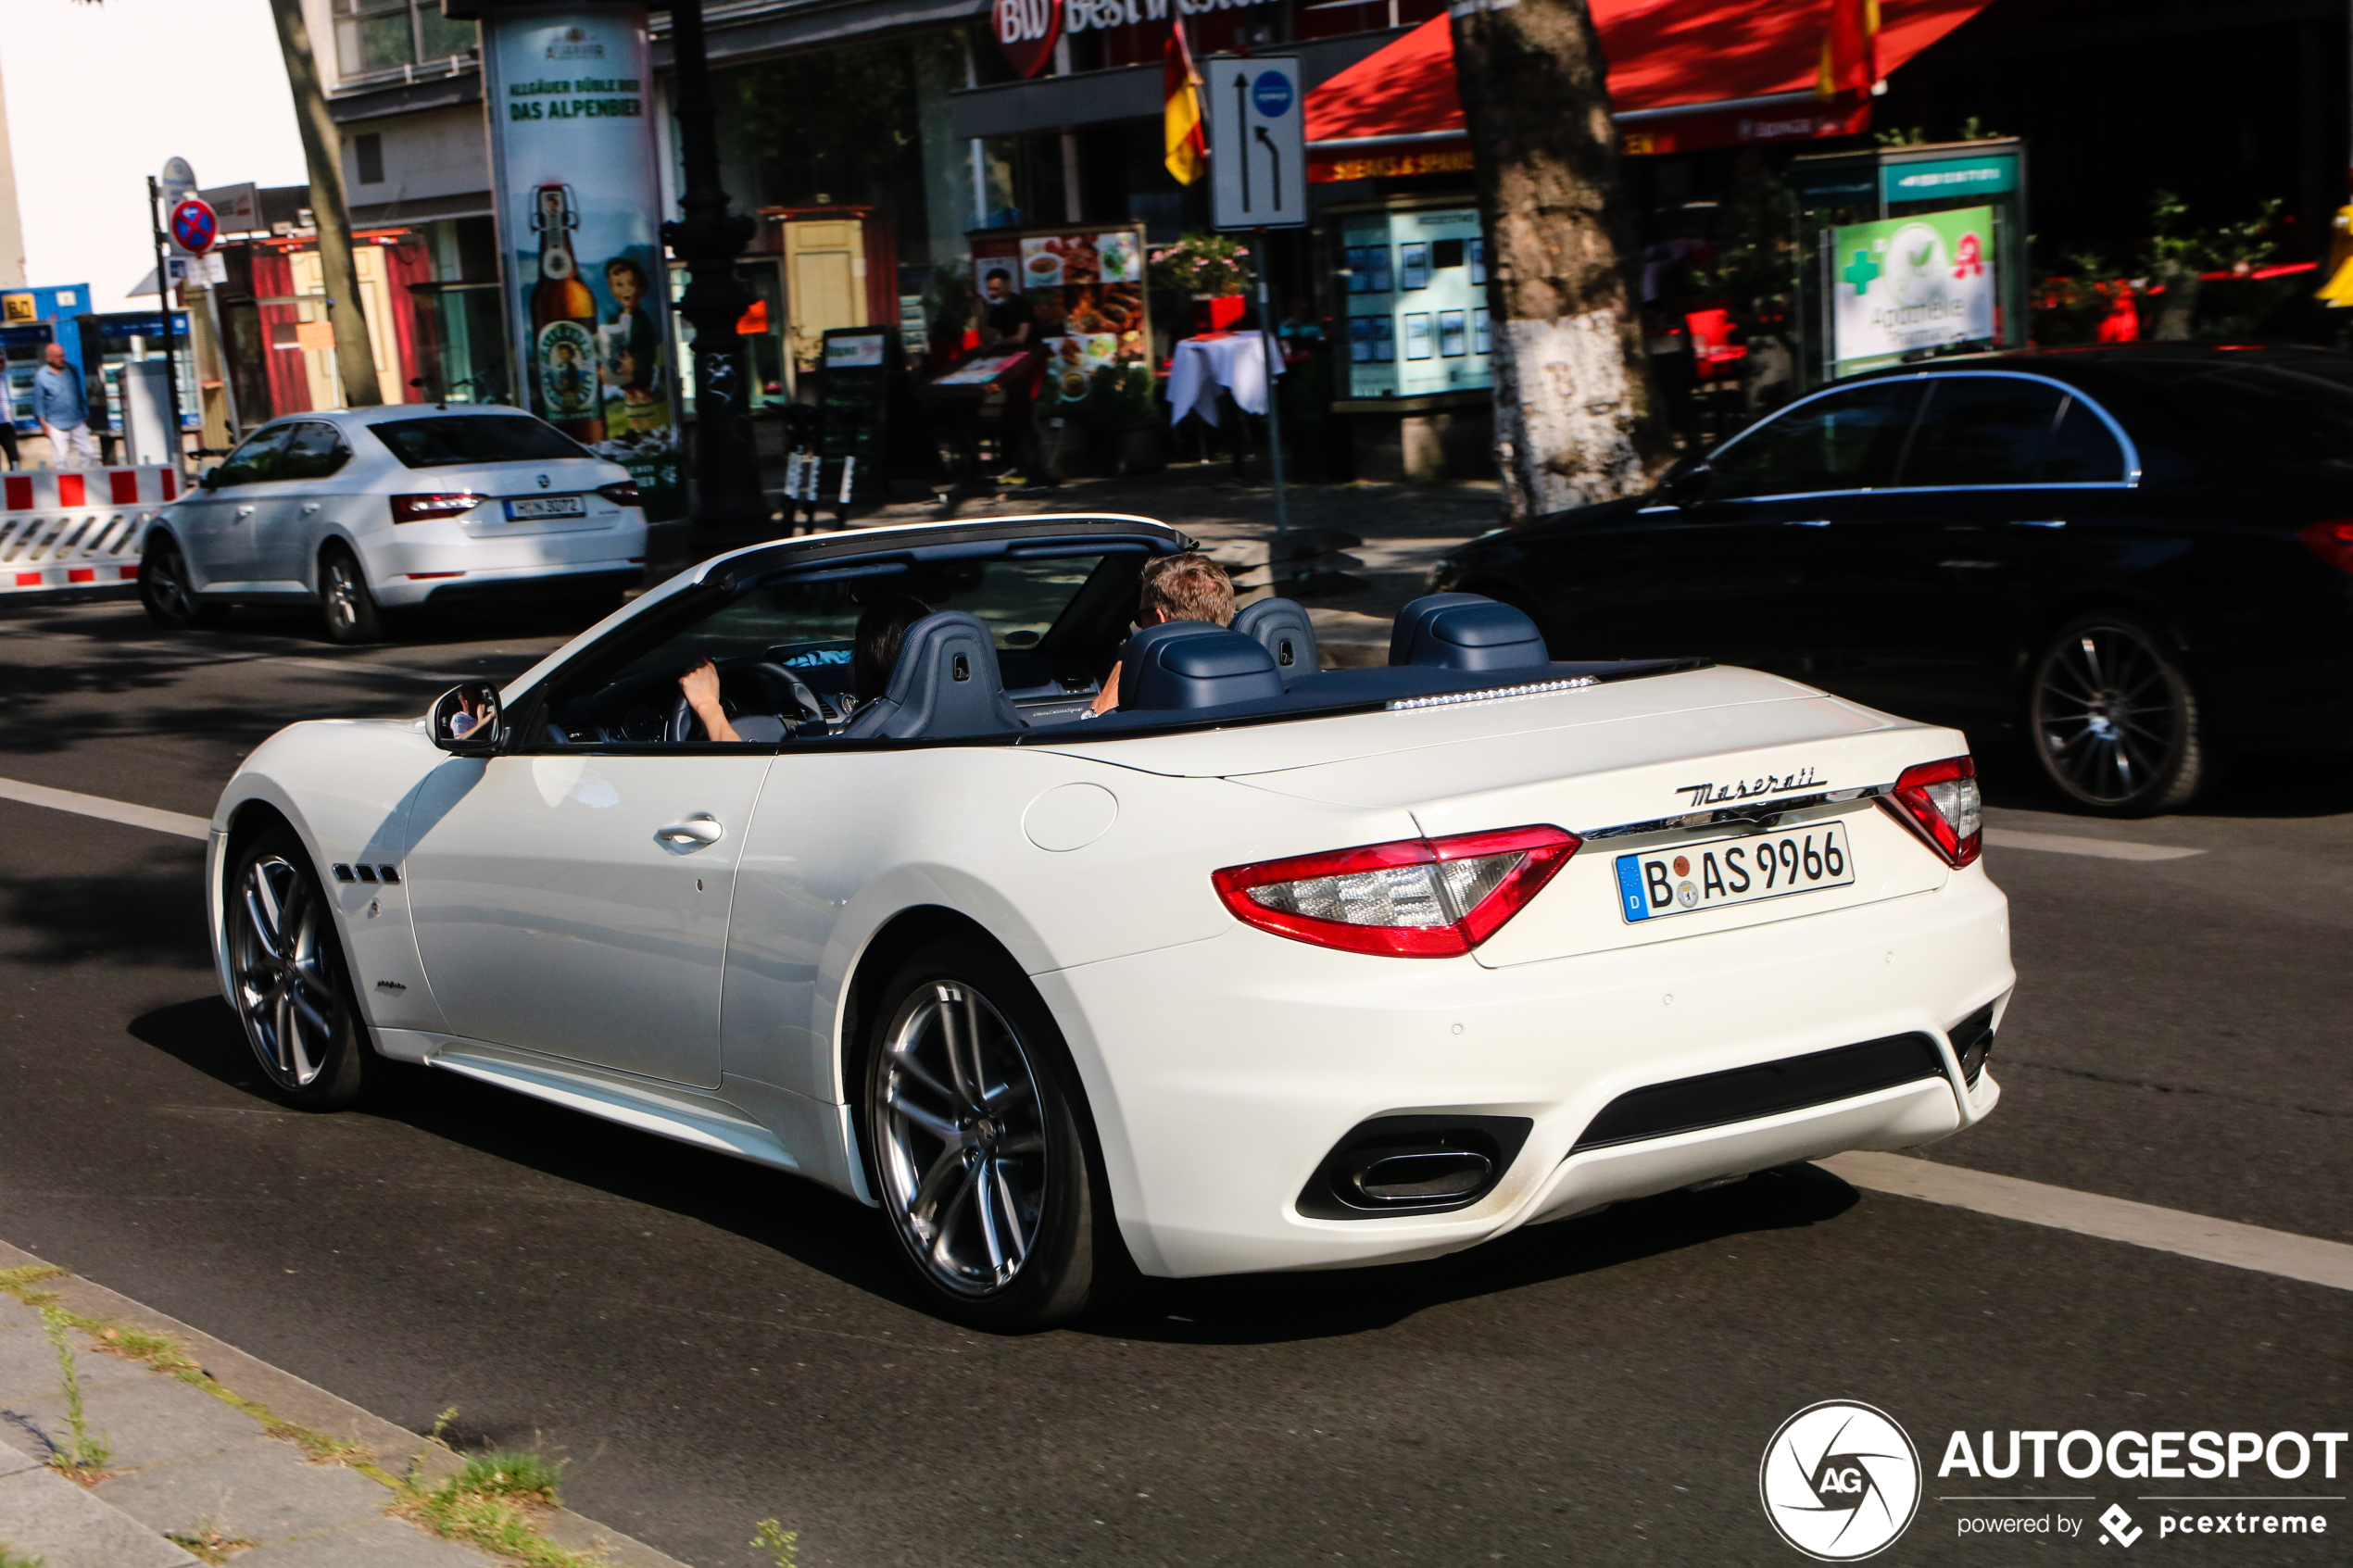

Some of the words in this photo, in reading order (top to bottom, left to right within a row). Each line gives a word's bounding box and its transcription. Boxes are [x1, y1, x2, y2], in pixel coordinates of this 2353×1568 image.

[1001, 0, 1049, 44] BW
[510, 102, 542, 120] DAS
[548, 99, 641, 118] ALPENBIER
[1674, 767, 1827, 806] Maserati
[1629, 895, 1640, 909] D
[1644, 861, 1673, 909] B
